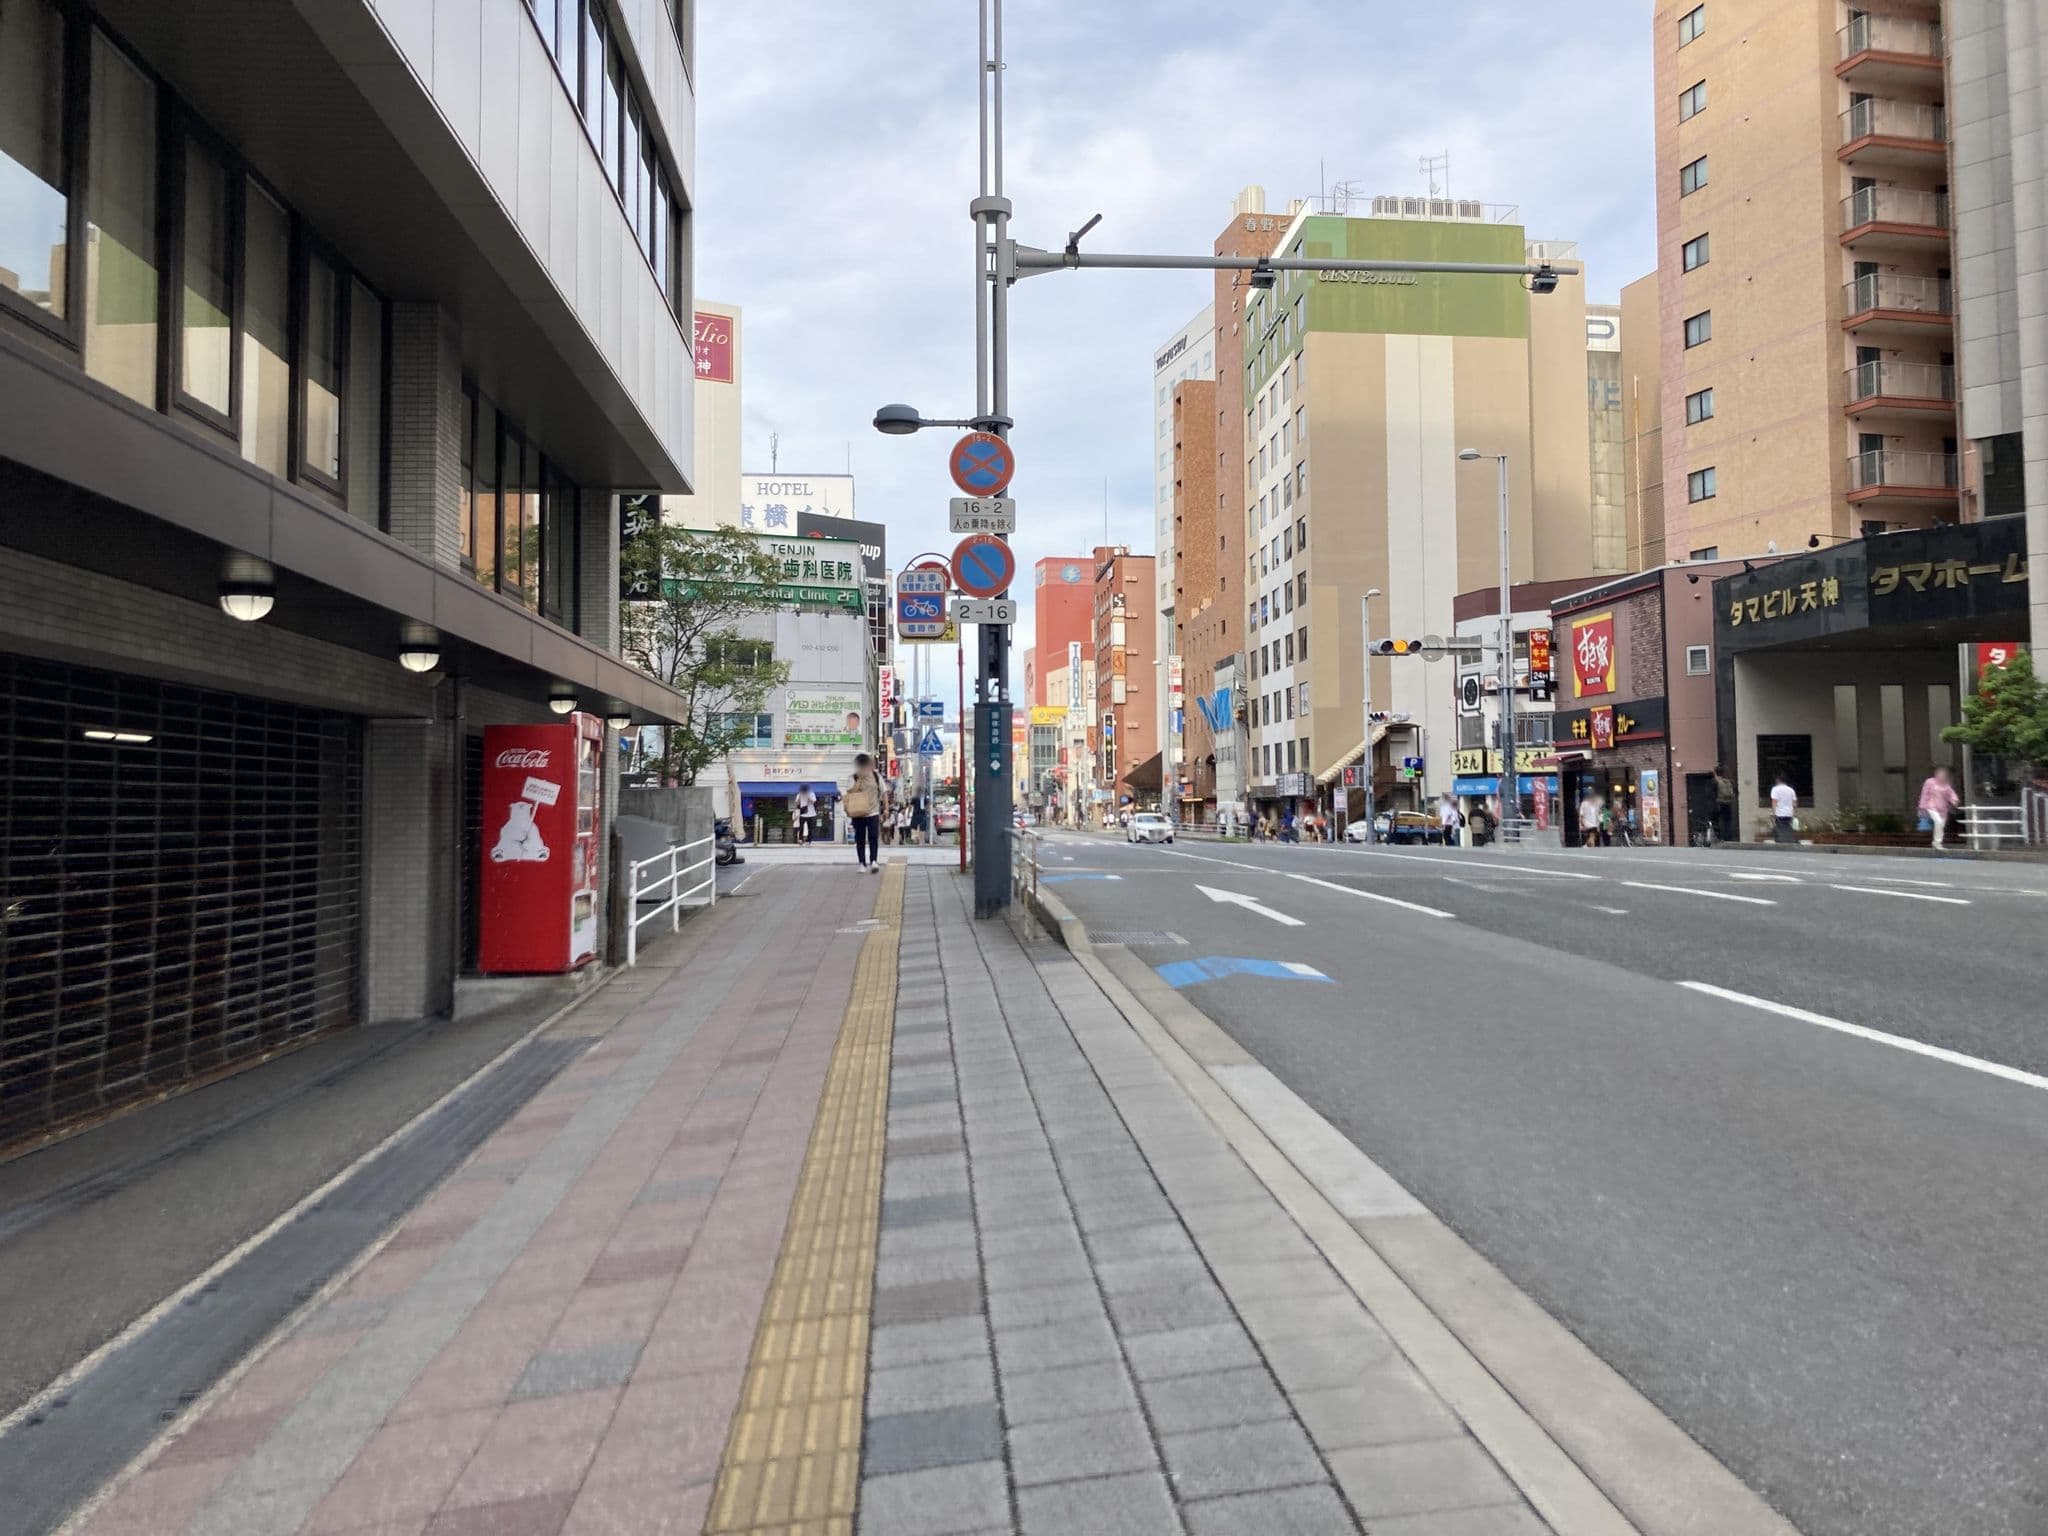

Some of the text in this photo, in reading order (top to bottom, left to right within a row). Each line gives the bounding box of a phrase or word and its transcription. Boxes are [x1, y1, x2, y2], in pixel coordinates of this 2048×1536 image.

[757, 482, 814, 496] HOTEL
[963, 501, 1003, 514] 16-2
[771, 543, 815, 557] TENJIN
[1730, 576, 1839, 627] タマビル天神
[959, 605, 1008, 619] 2-16
[1454, 753, 1479, 771] うどん
